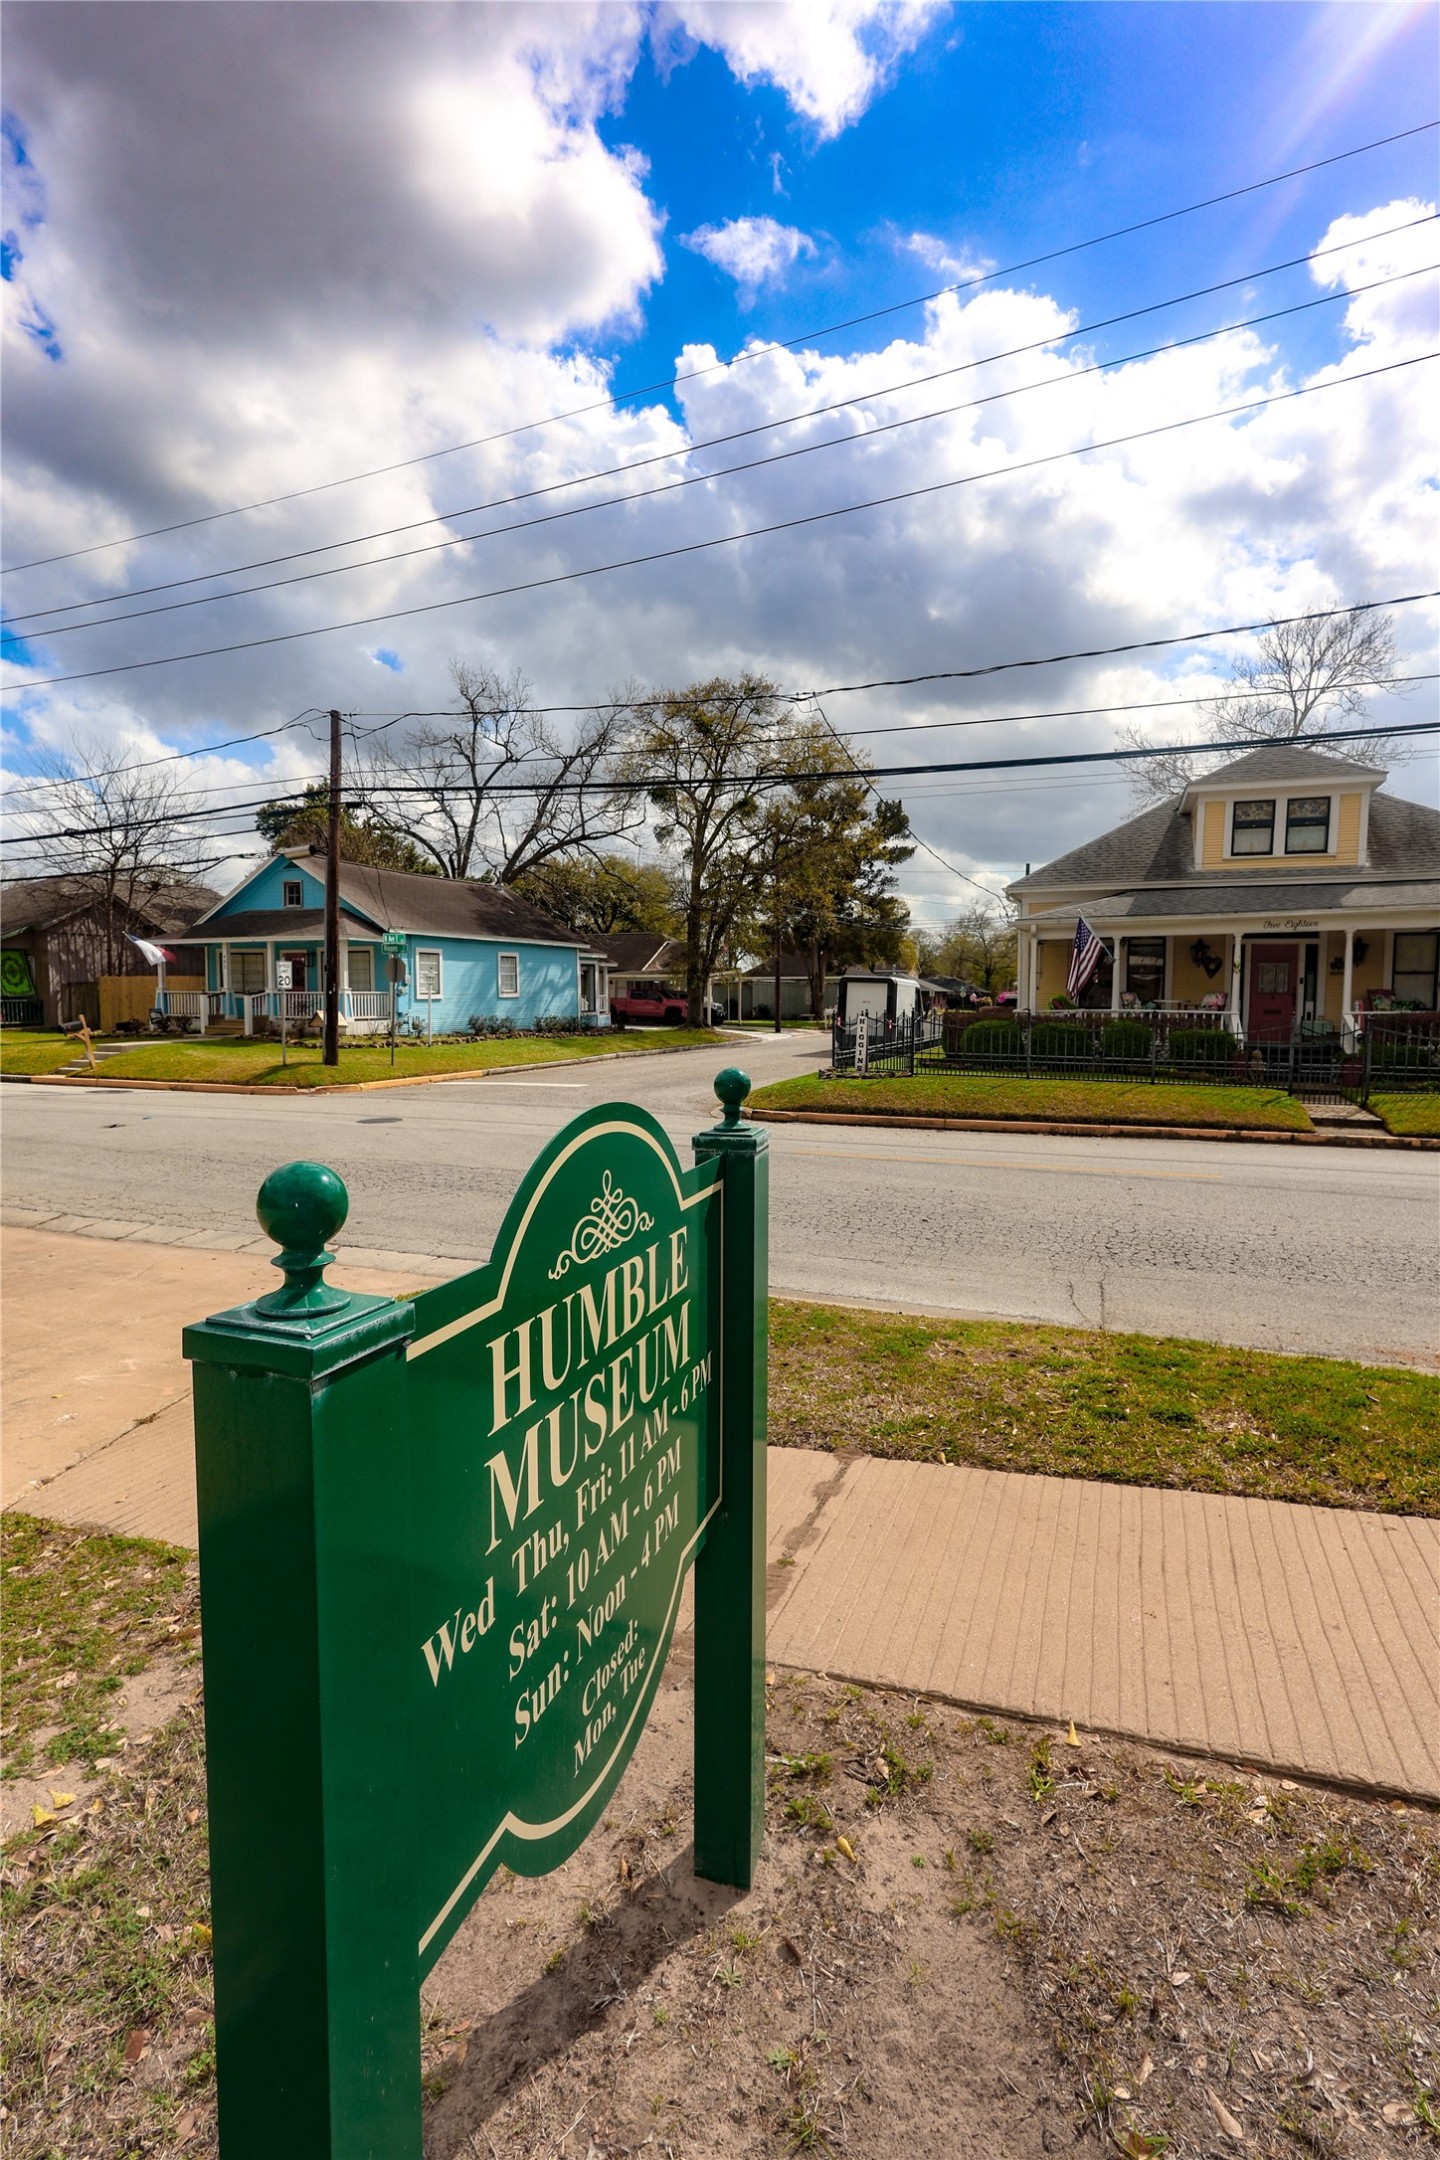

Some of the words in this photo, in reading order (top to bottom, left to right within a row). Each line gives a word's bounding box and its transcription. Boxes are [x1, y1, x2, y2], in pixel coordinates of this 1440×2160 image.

[278, 975, 290, 986] 20
[1285, 920, 1319, 931] Eighteen
[856, 1018, 865, 1071] HIGGINS
[486, 1226, 688, 1437] HUMBLE
[484, 1299, 690, 1555] MUSEUM
[421, 1576, 495, 1687] Wed
[512, 1520, 569, 1597] Thu,
[575, 1462, 612, 1532] Fri:
[619, 1433, 635, 1482] 11
[640, 1396, 668, 1459] AM
[681, 1375, 688, 1412] 6
[692, 1351, 712, 1401] PM
[509, 1596, 556, 1681] Sat:
[567, 1548, 589, 1610] 10
[594, 1498, 628, 1575] AM
[644, 1470, 652, 1510] 6
[657, 1436, 681, 1496] PM
[515, 1650, 568, 1750] Sun:
[576, 1575, 625, 1665] Noon
[641, 1531, 649, 1567] 4
[655, 1492, 679, 1555] PM
[582, 1619, 638, 1716] Closed:
[574, 1705, 616, 1778] Mon,
[620, 1647, 645, 1698] Tue
